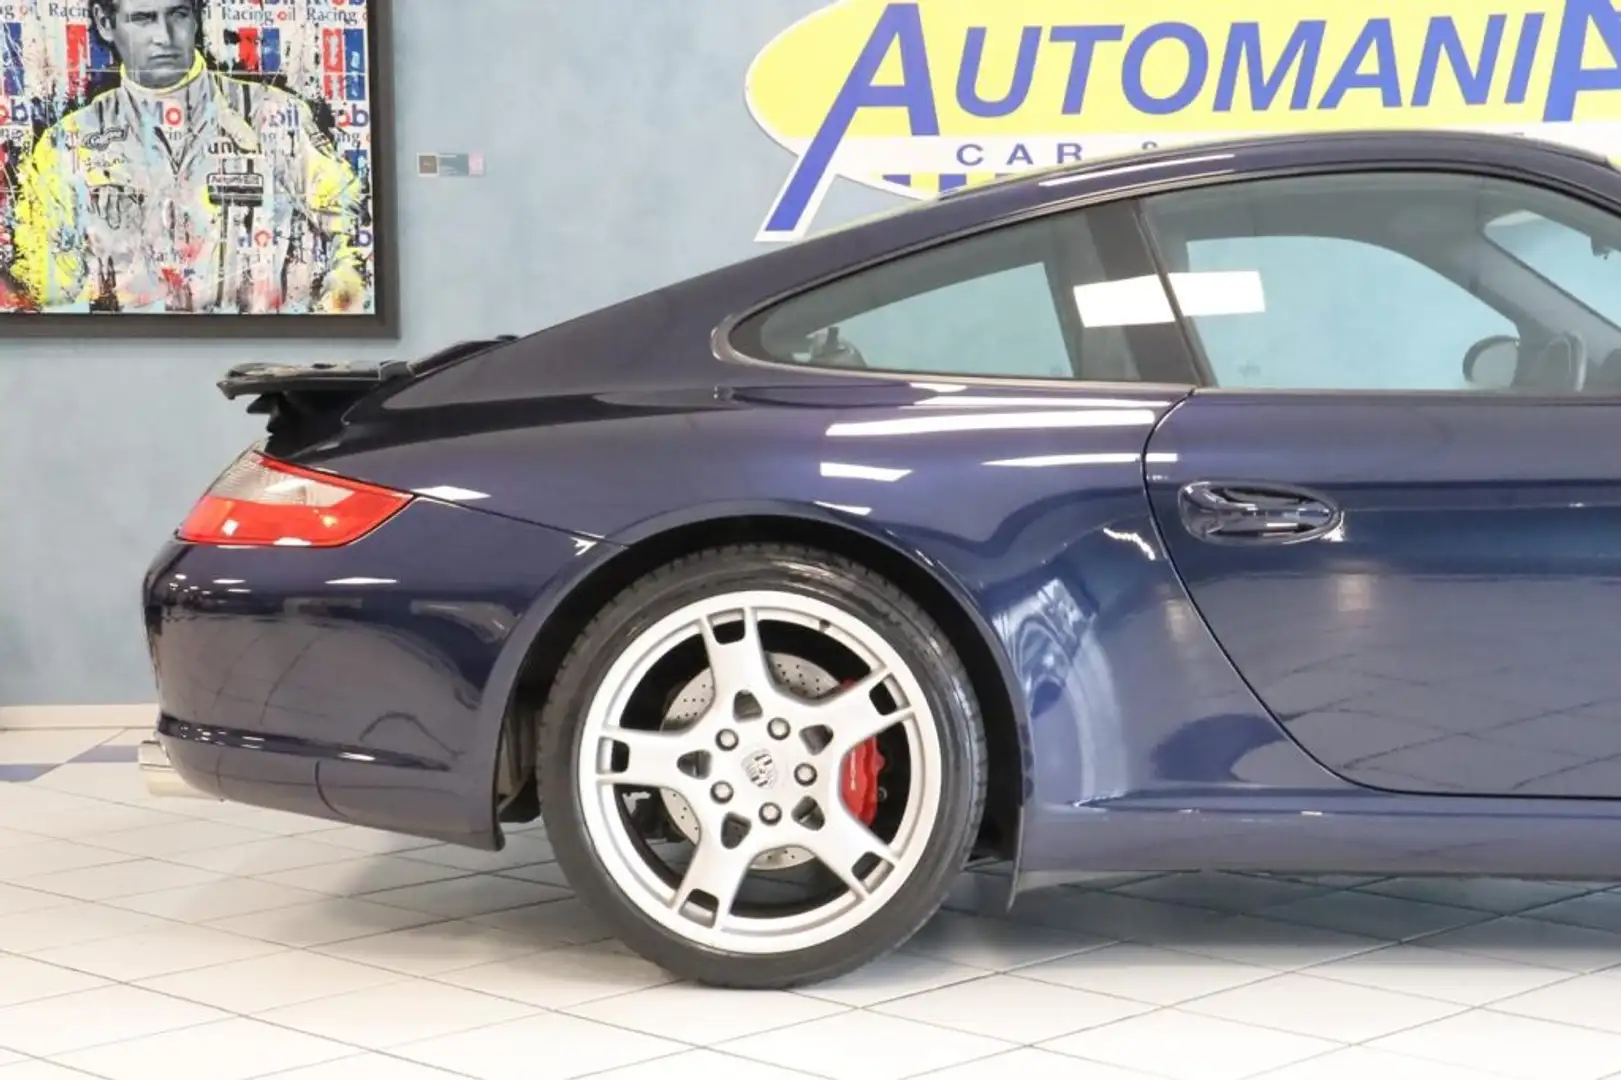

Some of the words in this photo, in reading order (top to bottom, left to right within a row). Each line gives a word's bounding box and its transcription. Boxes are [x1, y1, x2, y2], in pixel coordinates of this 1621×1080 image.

[222, 6, 273, 26] Racing
[277, 6, 296, 21] oil
[306, 6, 358, 25] Racing
[764, 0, 1621, 231] AUTOMANIA
[956, 142, 1084, 166] CAR
